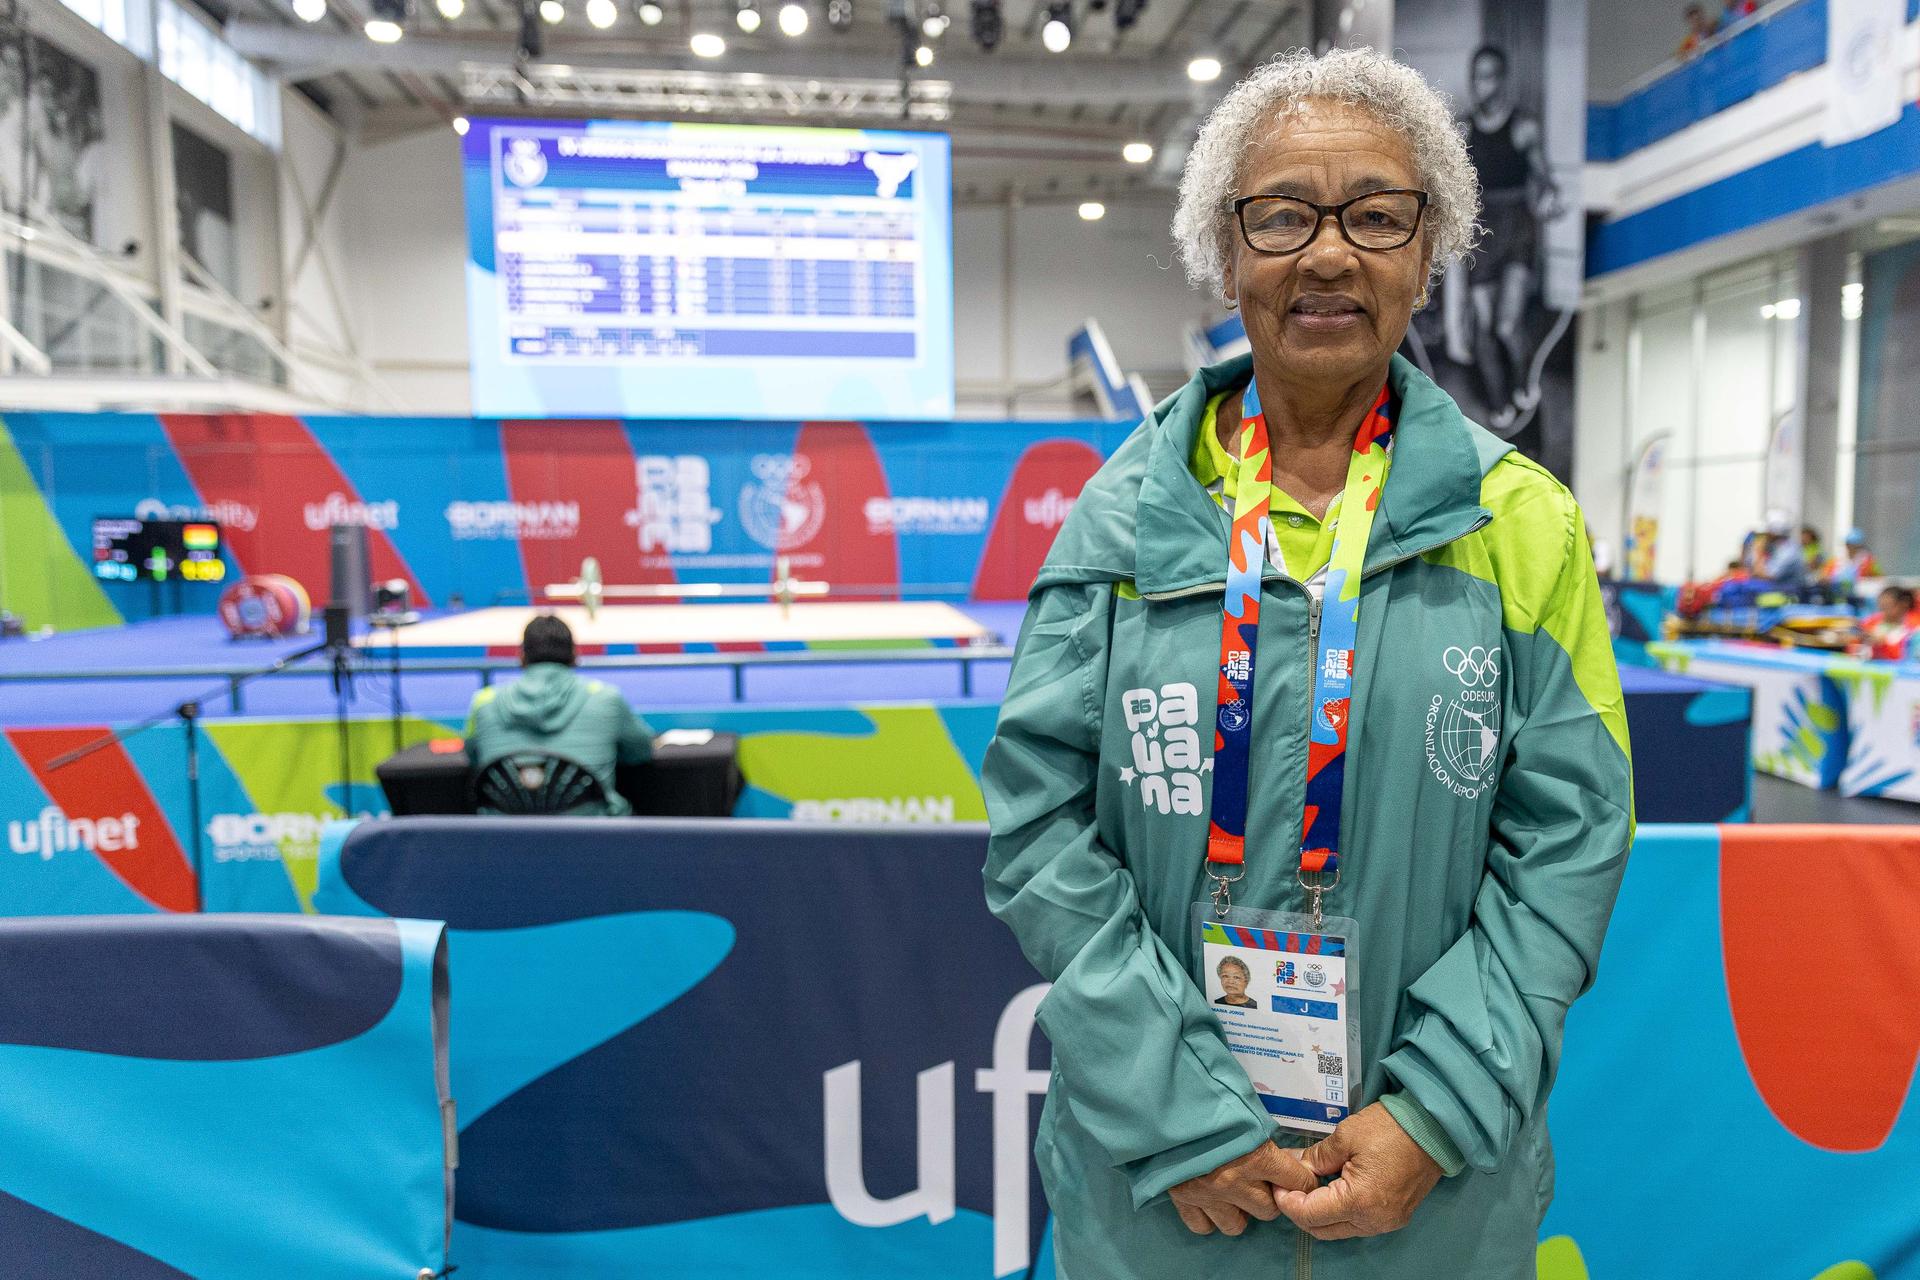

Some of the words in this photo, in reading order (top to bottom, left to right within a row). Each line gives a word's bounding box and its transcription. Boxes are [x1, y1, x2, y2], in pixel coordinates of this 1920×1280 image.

[304, 491, 398, 530] ufinet
[446, 500, 580, 529] BORNAN
[1461, 690, 1495, 703] ODESUR
[1425, 694, 1454, 790] ORGANIZACION
[794, 797, 954, 825] BORNAN
[8, 805, 140, 860] ufinet
[1301, 1003, 1309, 1013] J
